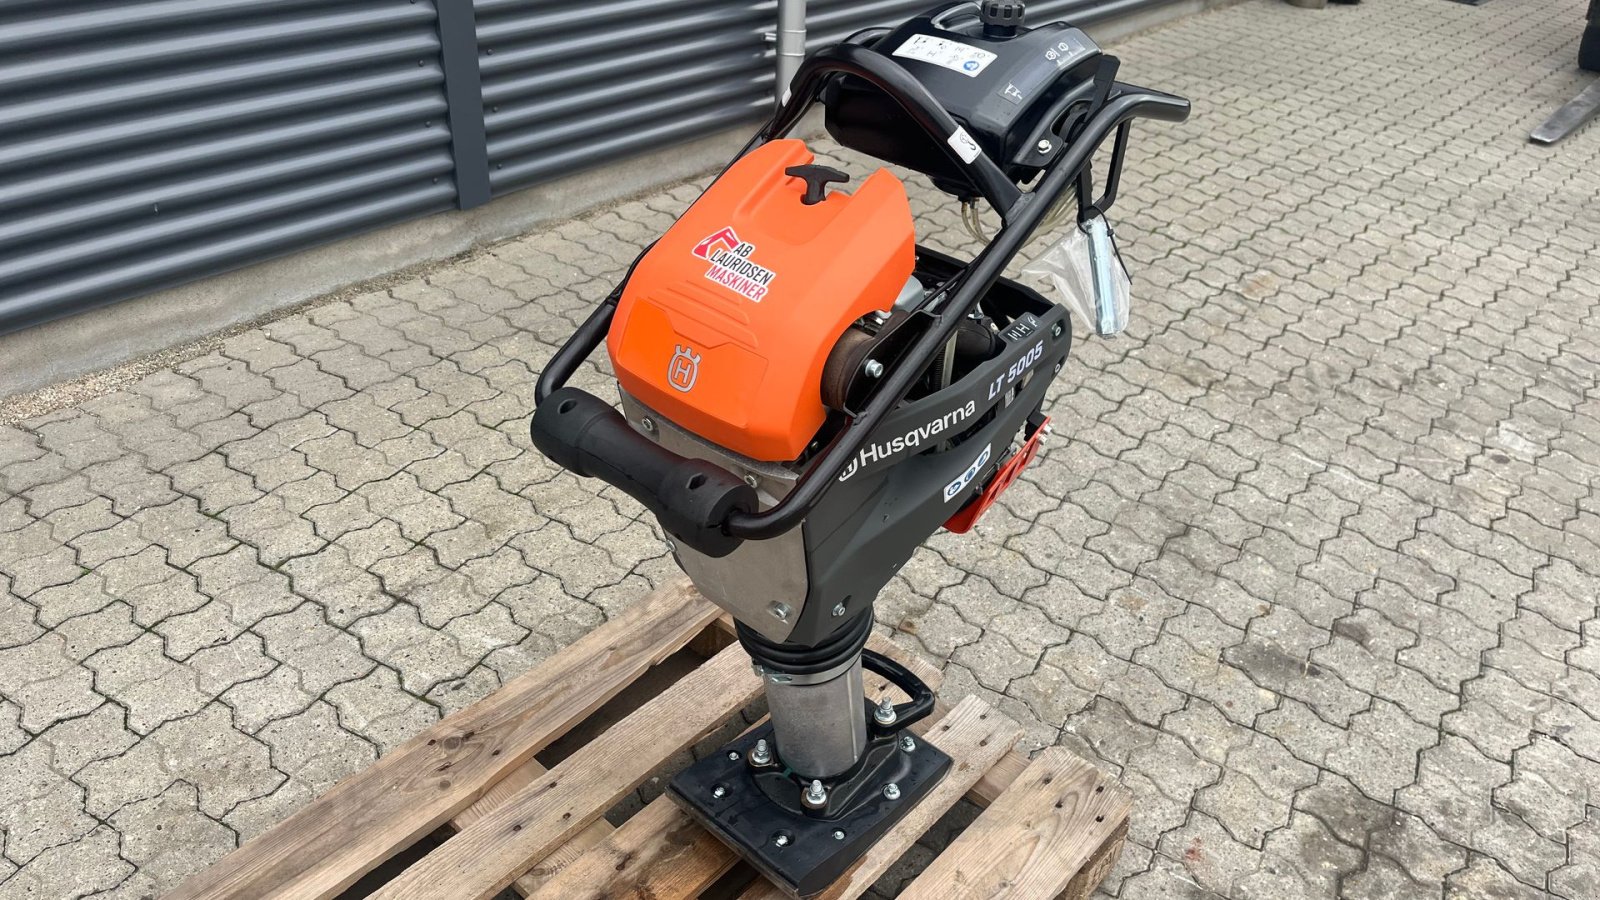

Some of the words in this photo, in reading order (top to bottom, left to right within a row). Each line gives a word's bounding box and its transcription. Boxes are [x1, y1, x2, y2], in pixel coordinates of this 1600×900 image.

[710, 249, 774, 286] LAURIDSEN
[733, 243, 753, 258] AB
[706, 265, 766, 301] MASKINER
[988, 373, 1006, 400] LT
[1007, 340, 1044, 383] 5005
[860, 399, 976, 468] Husqvarna
